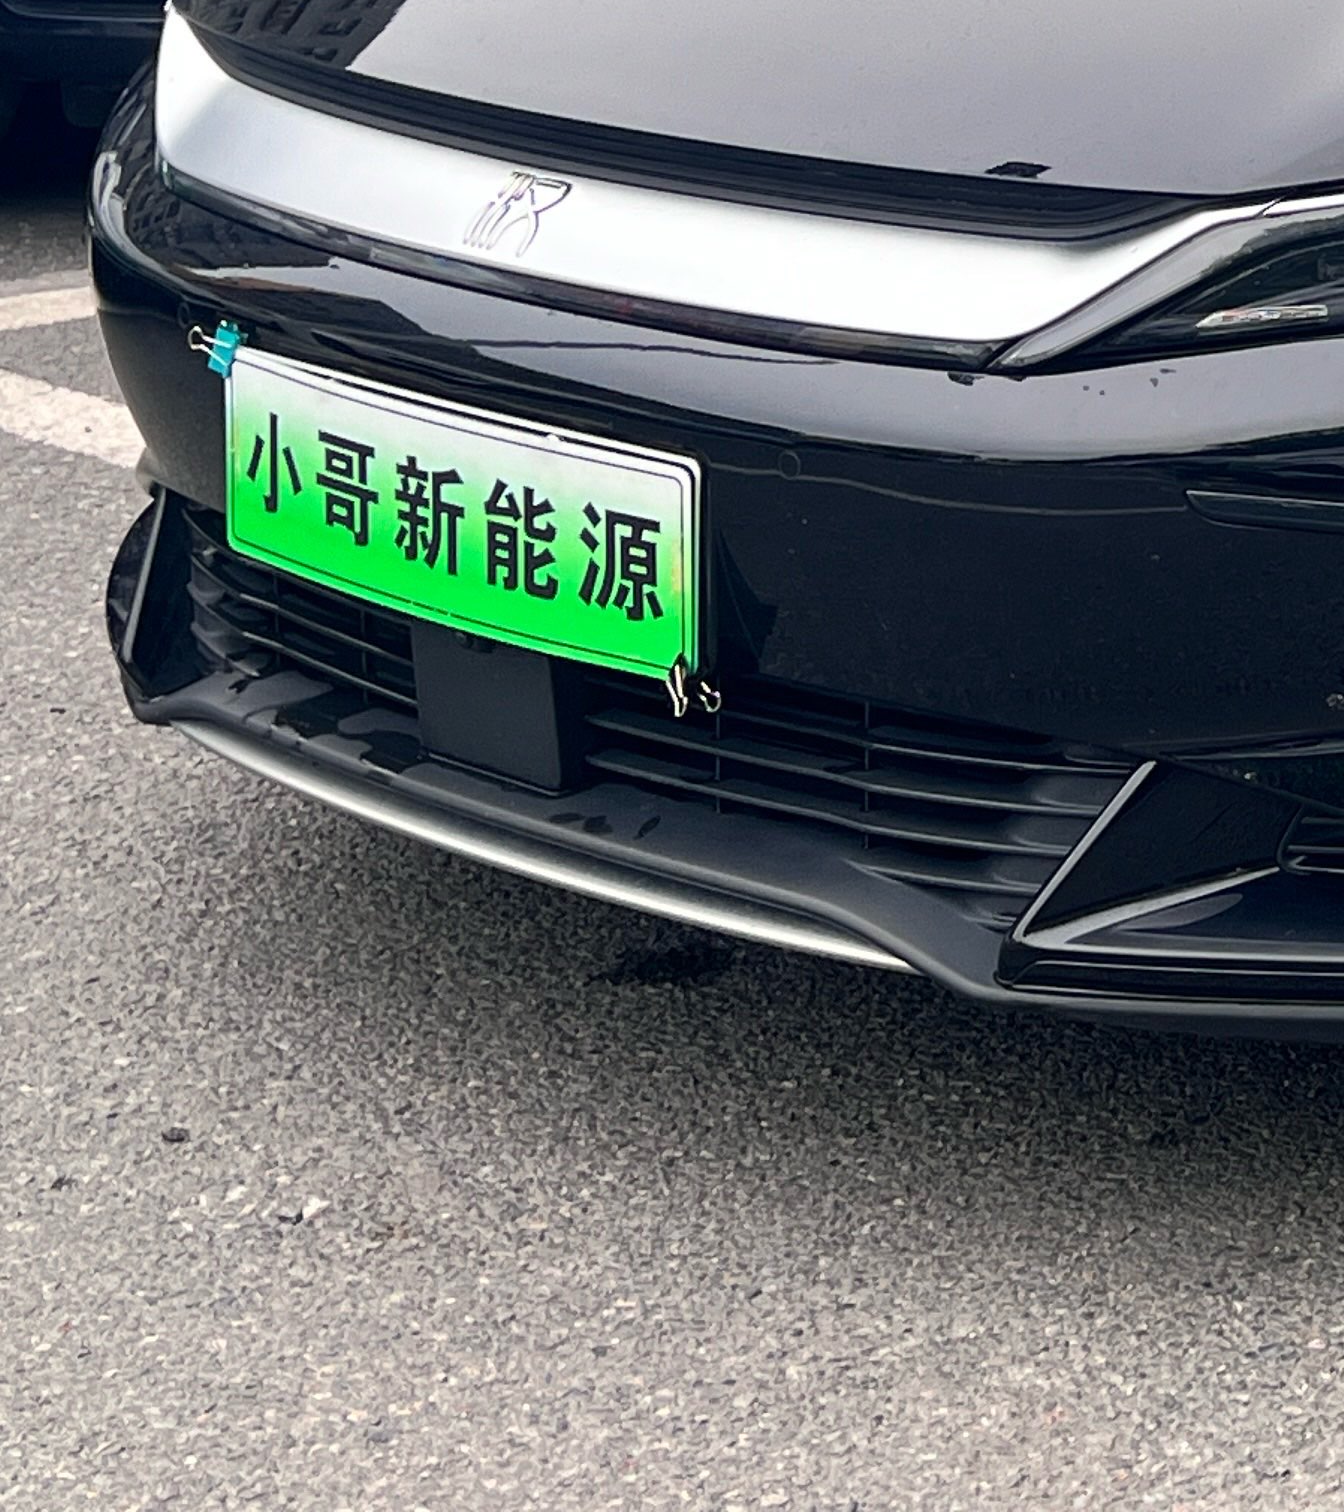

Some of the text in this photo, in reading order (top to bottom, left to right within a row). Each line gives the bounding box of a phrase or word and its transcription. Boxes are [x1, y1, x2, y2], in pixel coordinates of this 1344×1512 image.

[246, 412, 662, 621] 小哥新能源
